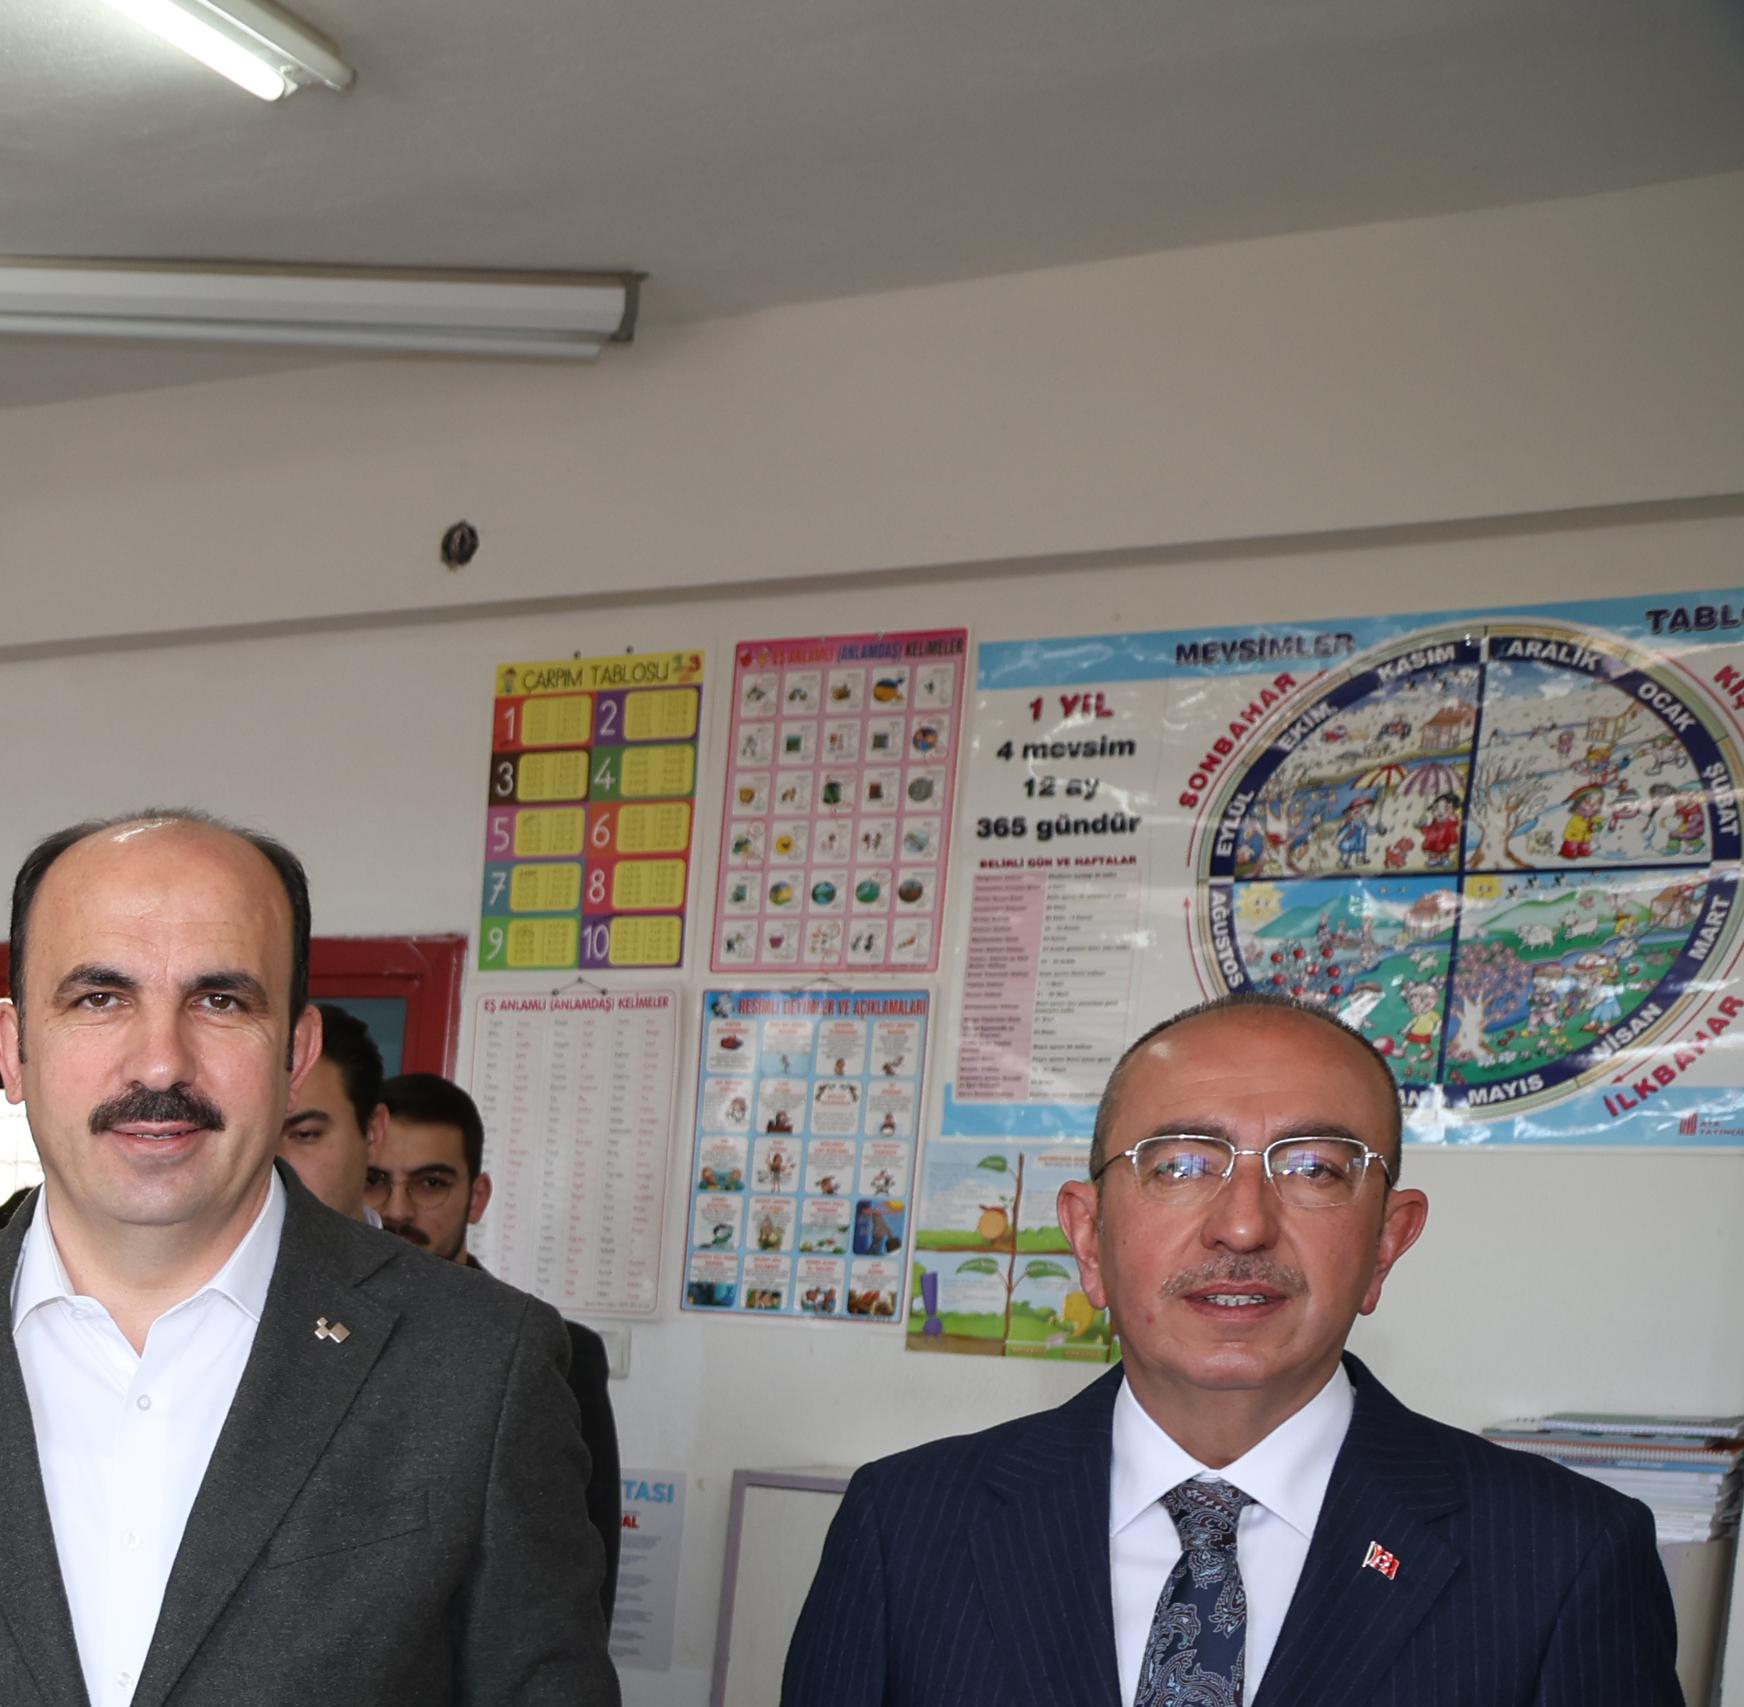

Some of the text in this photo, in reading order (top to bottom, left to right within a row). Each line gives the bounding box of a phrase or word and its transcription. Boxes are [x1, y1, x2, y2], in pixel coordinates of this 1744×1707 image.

[904, 637, 964, 658] KELİMELER
[1174, 604, 1744, 668] MEVSİMLER TABL
[523, 661, 670, 692] ÇARPIM TABLOSU
[1377, 645, 1455, 680] KASIM
[504, 706, 515, 743] 1
[599, 699, 618, 736] 2
[1029, 695, 1043, 722] 1
[1637, 682, 1697, 733] OCAK
[997, 734, 1136, 760] 4 mevsim
[1178, 672, 1297, 809] SONBAHAR
[1281, 711, 1330, 751] EKİM
[496, 762, 514, 796] 3
[594, 757, 616, 791] 4
[1024, 777, 1100, 800] 12 ay
[1703, 762, 1740, 836] ŞUBAT
[494, 816, 510, 851] 5
[591, 813, 610, 848] 6
[977, 813, 1141, 841] 365 gündür
[1216, 790, 1255, 857] EYLÜL
[1028, 857, 1053, 868] GÜN
[1056, 857, 1071, 867] VE
[489, 871, 506, 906] 7
[588, 868, 606, 904] 8
[486, 926, 504, 961] 9
[583, 923, 610, 960] 10
[1212, 890, 1245, 988] AĞUSTOS
[1688, 894, 1730, 961] MART
[483, 992, 670, 1014] EŞ ANLAMLI (ANLAMDAŞ) KELİMELER
[839, 999, 850, 1015] VE
[854, 999, 928, 1019] AÇIKLAMALARI
[1592, 1002, 1664, 1059] NİSAN
[1467, 1073, 1545, 1106] MAYIS
[622, 1479, 675, 1504] TASI
[619, 1514, 641, 1529] AL
